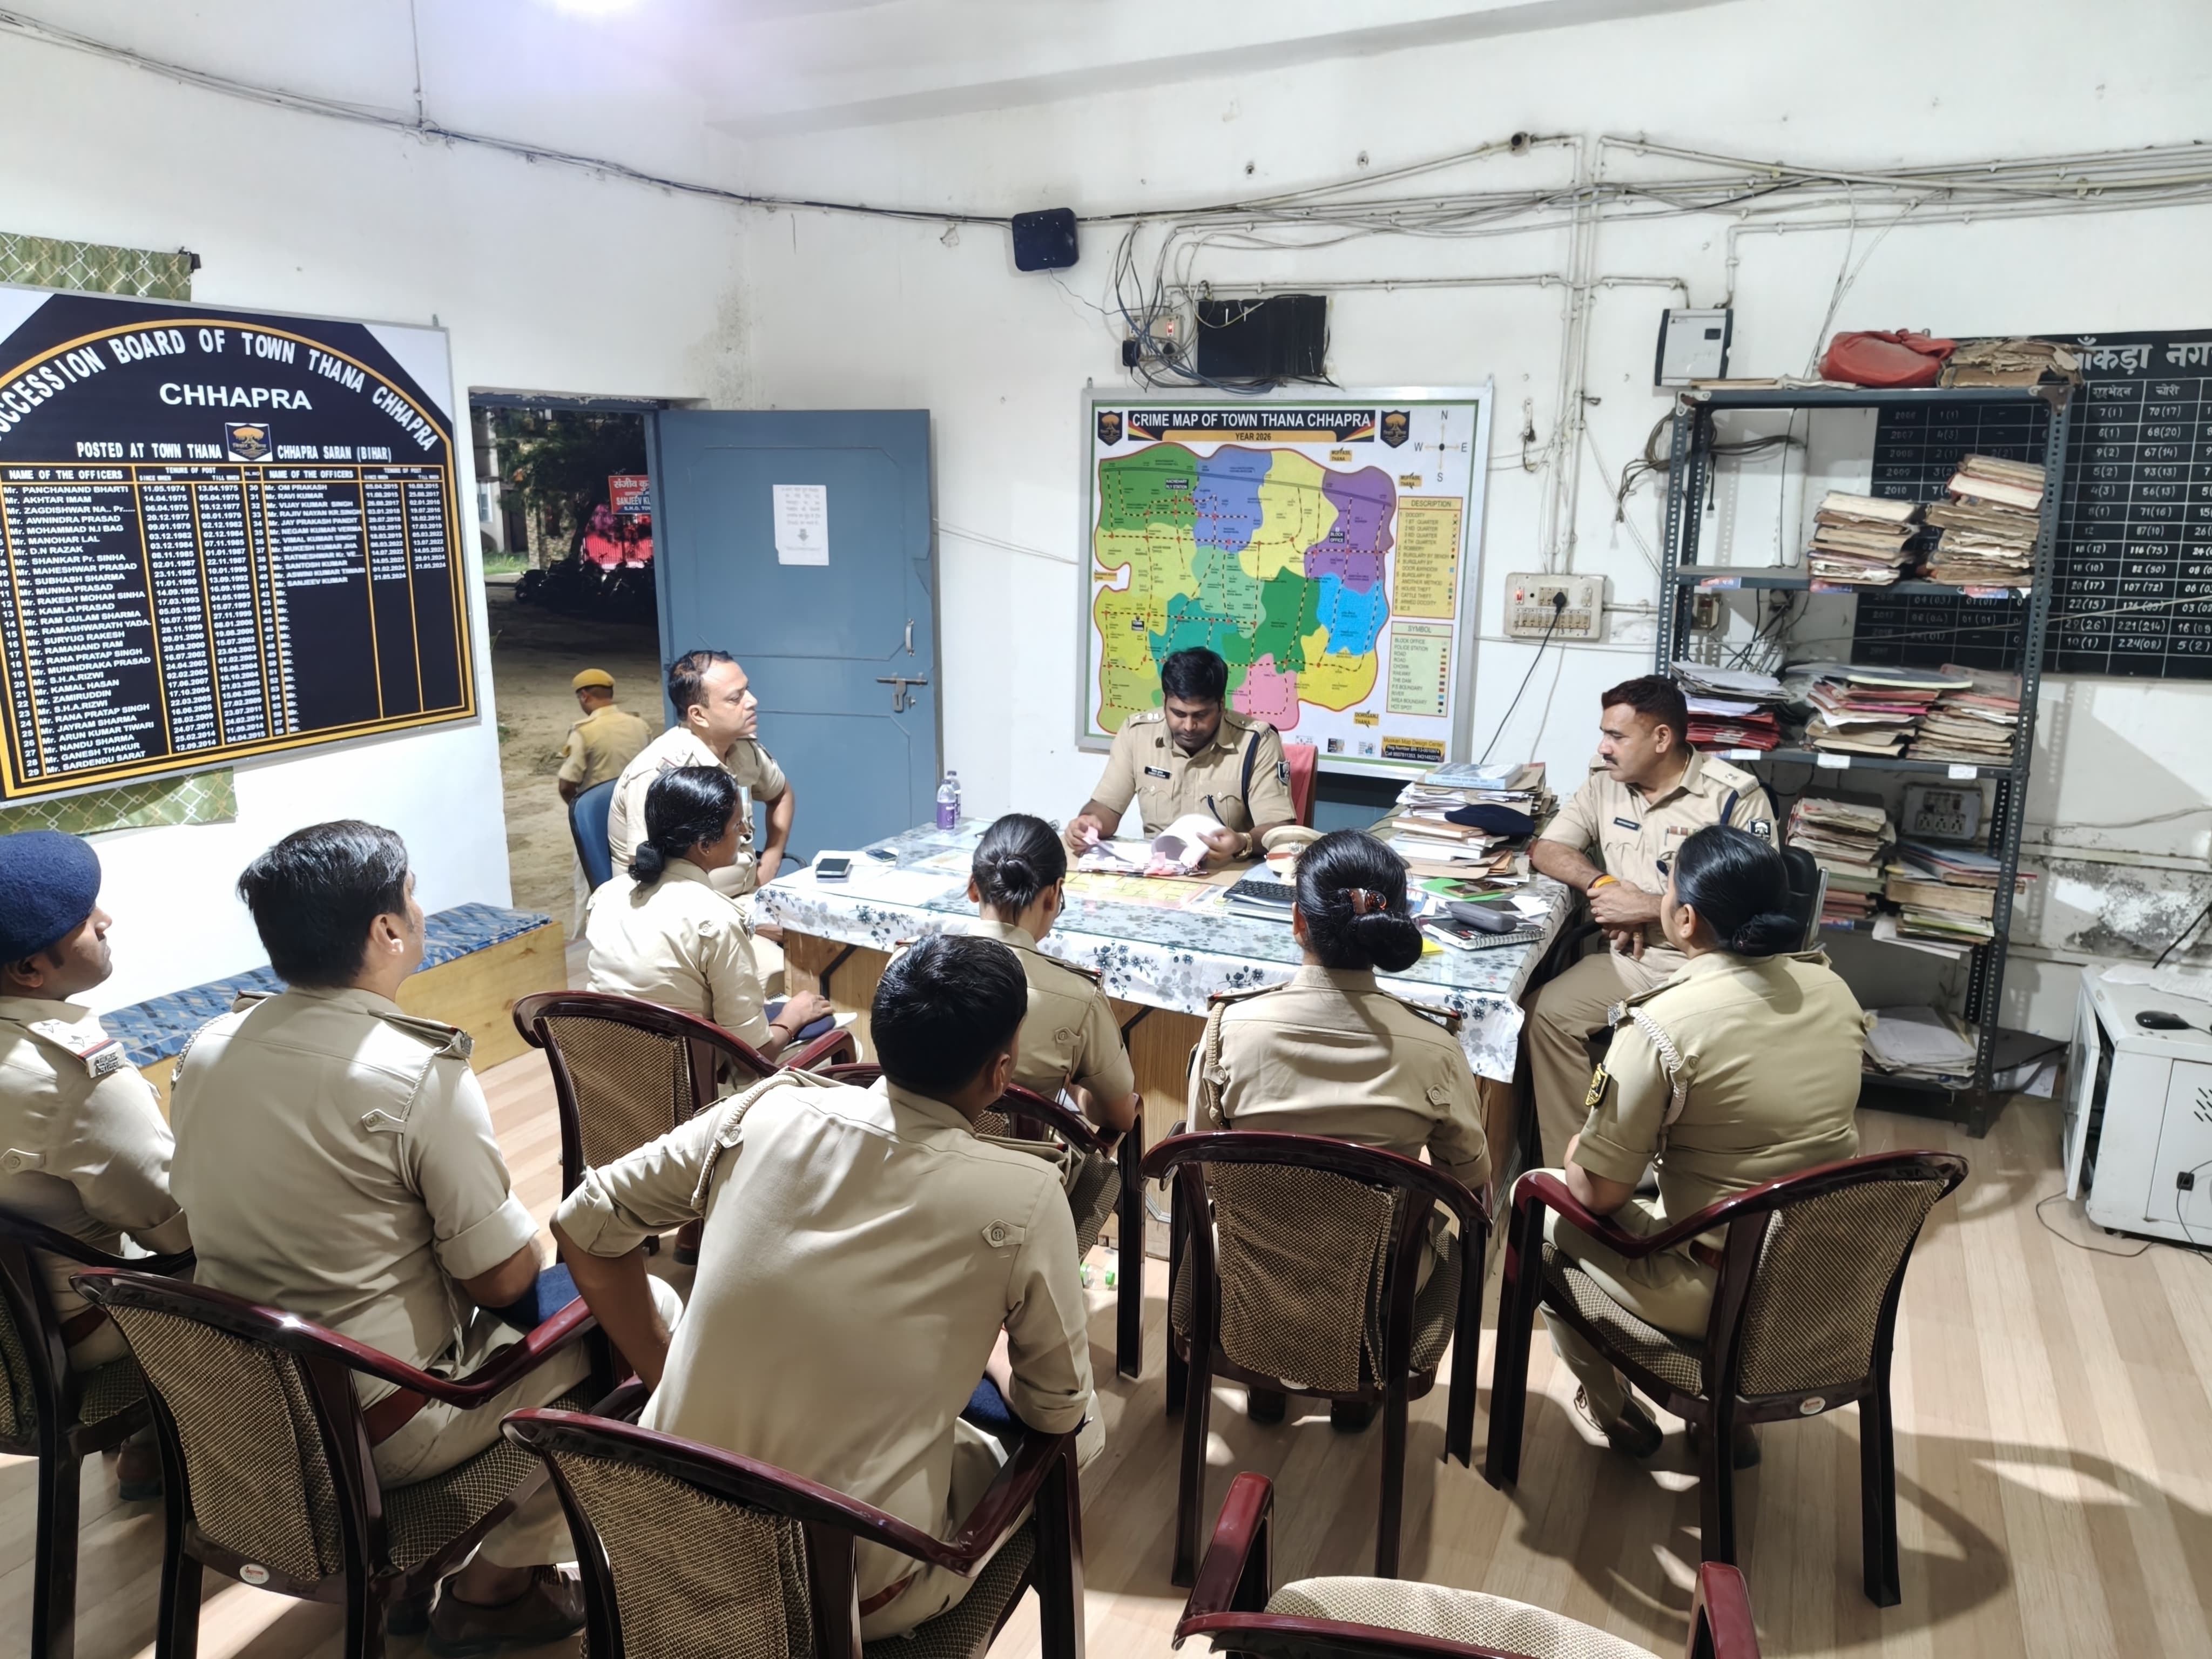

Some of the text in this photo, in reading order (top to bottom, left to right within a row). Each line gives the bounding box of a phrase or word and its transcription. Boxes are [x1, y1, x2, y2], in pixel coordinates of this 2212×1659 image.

[0, 328, 439, 451] CCESSION BOARD OF TOWN THANA CHHAPRA
[159, 383, 313, 410] CHHAPRA
[1441, 410, 1448, 420] N
[1132, 414, 1371, 428] CRIME MAP OF TOWN THANA CHHAPRA
[1235, 433, 1271, 441] YEAR 2026
[1414, 442, 1422, 451] W
[1461, 443, 1468, 452] E
[77, 442, 392, 463] POSTED AT TOWN THANA CHHAPRA SARAN (BIHAR)
[8, 470, 124, 480] NAME OF THE OFFICERS
[269, 470, 290, 479] NAME
[291, 470, 301, 479] OF
[304, 470, 318, 479] THE
[321, 470, 354, 479] OFFICERS
[1437, 473, 1443, 482] S
[23, 486, 92, 494] PANCHANAND
[23, 496, 64, 504] AKHTAR
[66, 495, 92, 503] IMAM
[616, 496, 642, 506] SANJEEV
[1411, 500, 1452, 508] DESCRIPTION
[8, 515, 121, 525] Mr. AWNINDRA PRASAD
[10, 528, 25, 536] Mr.
[27, 526, 87, 535] MOHAMMAD
[103, 524, 124, 532] BAG
[11, 535, 100, 546] Mr. MANOHAR LAL
[12, 545, 84, 556] Mr. D.N RAZAK
[14, 558, 29, 567] Mr.
[31, 556, 80, 565] SHANKAR
[96, 554, 126, 562] SINHA
[16, 563, 138, 577] Mr. MAHESHWAR PRASAD
[17, 573, 126, 587] Mr. SUBHASH SHARMA
[19, 583, 114, 597] Mr. MUNNA PRASAD
[21, 591, 146, 607] Mr. RAKESH MOHAN SINHA
[2, 610, 15, 618] 13
[22, 603, 116, 617] Mr. KAMLA PRASAD
[33, 672, 105, 687] Mr. S.H.A.RIZWI
[34, 679, 120, 697] Mr. KAMAL HASAN
[36, 690, 112, 706] Mr. ZAMIRUDDIN
[46, 751, 146, 774] Mr. SARDENDU SARAT
[28, 768, 40, 777] 29
